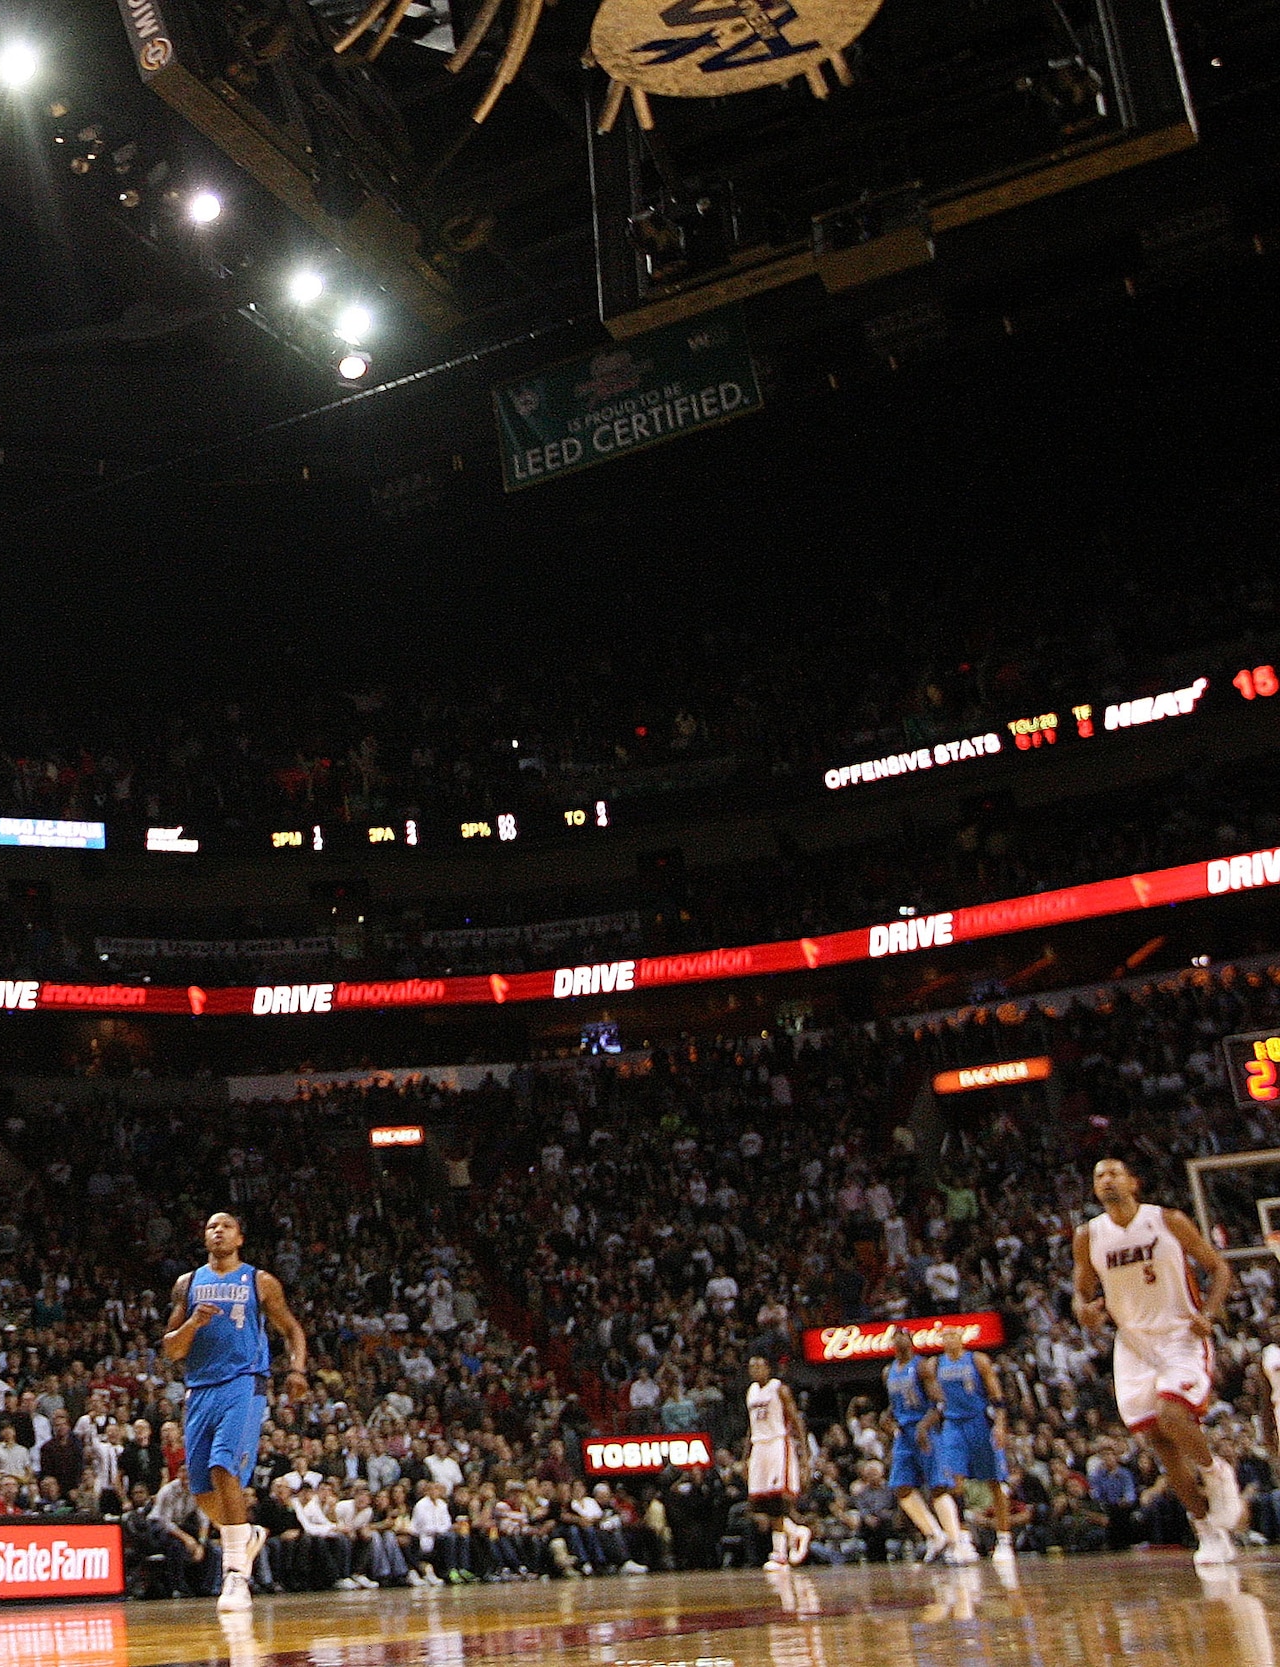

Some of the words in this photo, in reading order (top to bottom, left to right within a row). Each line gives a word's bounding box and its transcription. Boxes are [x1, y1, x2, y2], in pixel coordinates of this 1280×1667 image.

[584, 399, 636, 427] PROUD
[639, 389, 660, 407] TO
[513, 437, 583, 479] LEED
[592, 381, 751, 452] CERTIFIED.
[1104, 677, 1208, 731] HEAT
[824, 747, 932, 790] OFFENSIVE
[933, 732, 1003, 766] STATS
[564, 809, 586, 826] TO
[1207, 849, 1280, 894] DRIV
[868, 912, 954, 957] DRIVE
[958, 893, 1077, 934] innovation
[553, 960, 635, 998] DRIVE
[640, 948, 752, 981] innovation
[252, 984, 334, 1015] DRIVE
[337, 979, 445, 1004] innovation
[1105, 1236, 1158, 1269] HEAT
[1142, 1264, 1156, 1285] 5
[229, 1303, 246, 1329] 4
[587, 1439, 710, 1469] TOSHIBA
